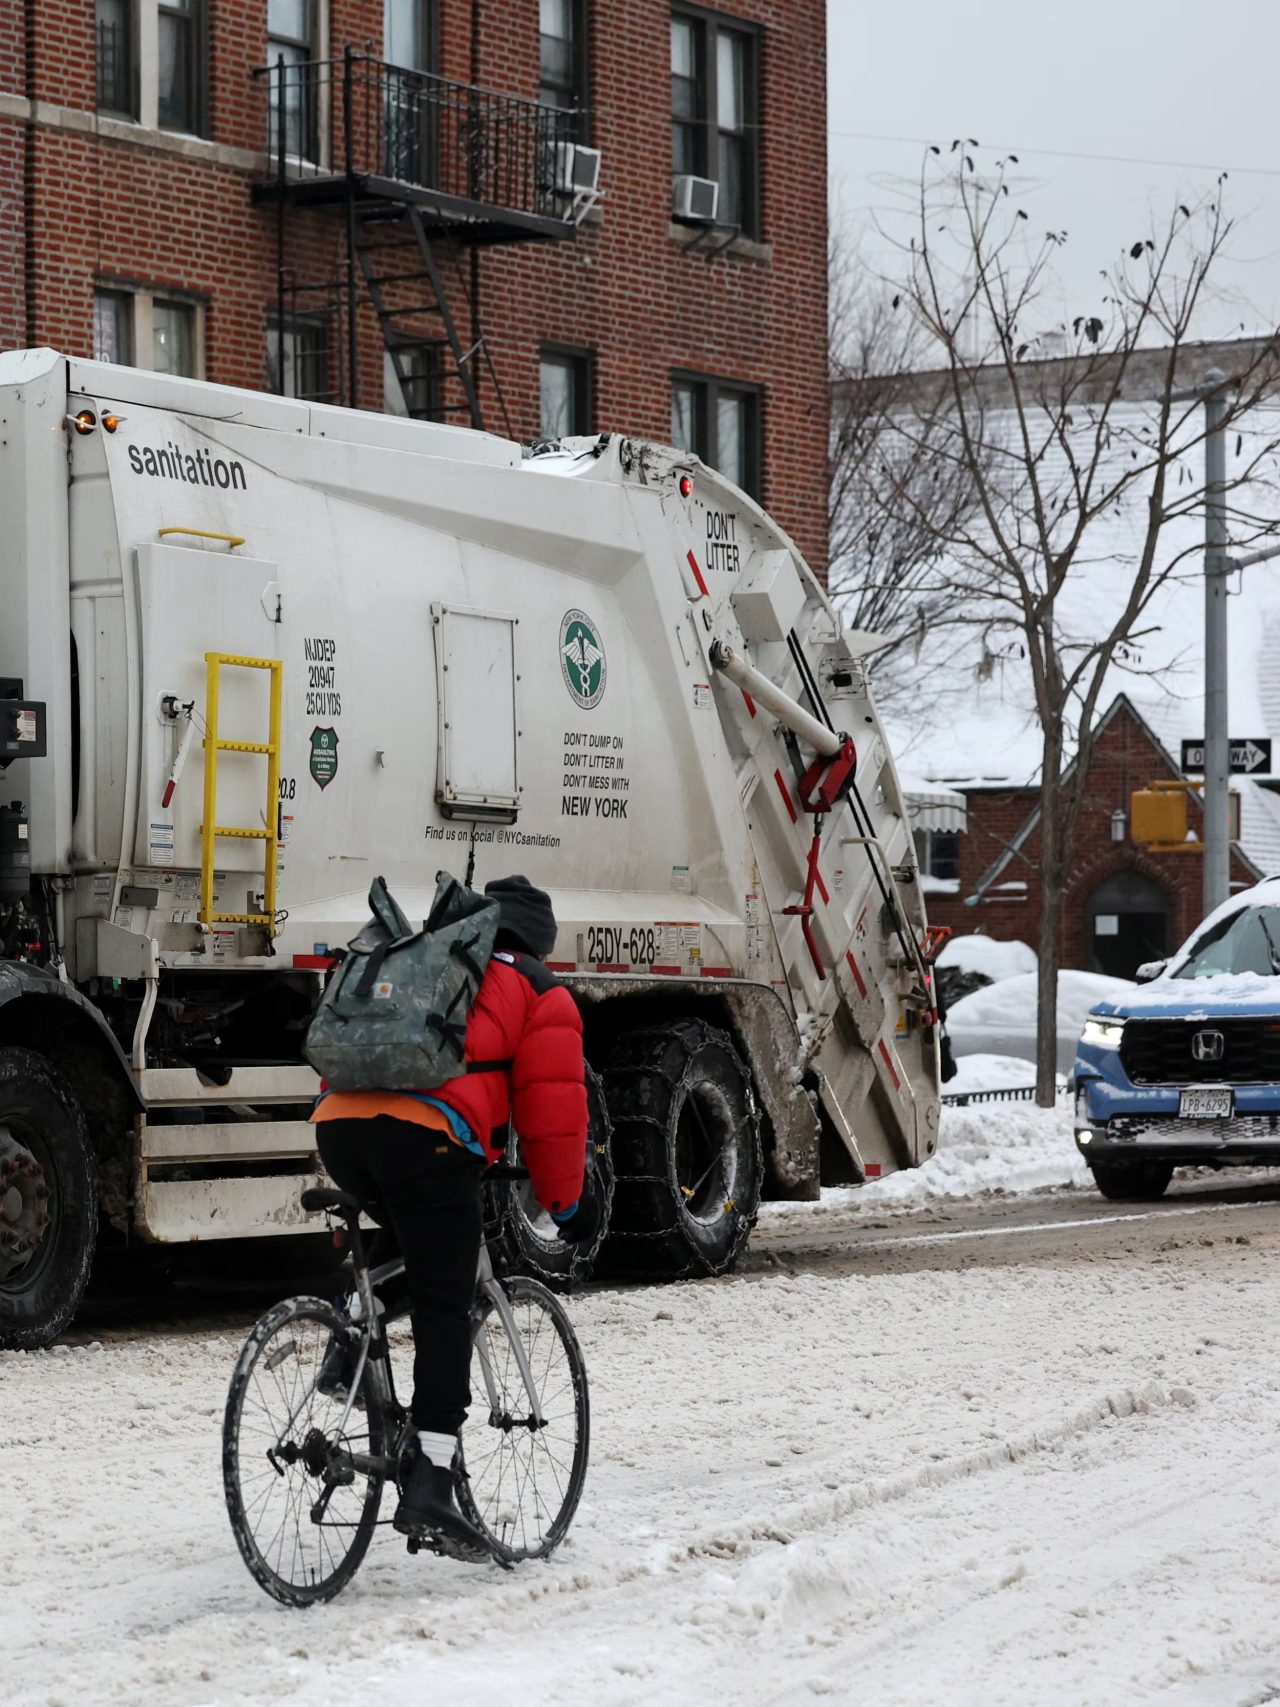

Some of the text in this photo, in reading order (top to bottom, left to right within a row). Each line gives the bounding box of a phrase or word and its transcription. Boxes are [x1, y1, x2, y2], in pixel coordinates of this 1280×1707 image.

[128, 441, 247, 490] sanitation
[706, 511, 736, 541] DON'T
[706, 541, 740, 572] LITTER
[304, 638, 336, 661] NJDEP
[309, 666, 335, 688] 20947
[306, 692, 342, 716] 25 CU YDS
[564, 732, 623, 749] DON'T DUMP ON
[564, 753, 624, 770] DON'T LITTER IN
[1231, 750, 1257, 763] WAY
[278, 778, 296, 799] 0.8
[563, 774, 629, 790] DON'T MESS WITH
[562, 795, 628, 819] NEW YORK
[424, 826, 444, 840] Find
[445, 830, 456, 840] us
[458, 831, 468, 841] on
[496, 830, 561, 847] @NYCsanitation
[587, 926, 655, 965] 25DY-628
